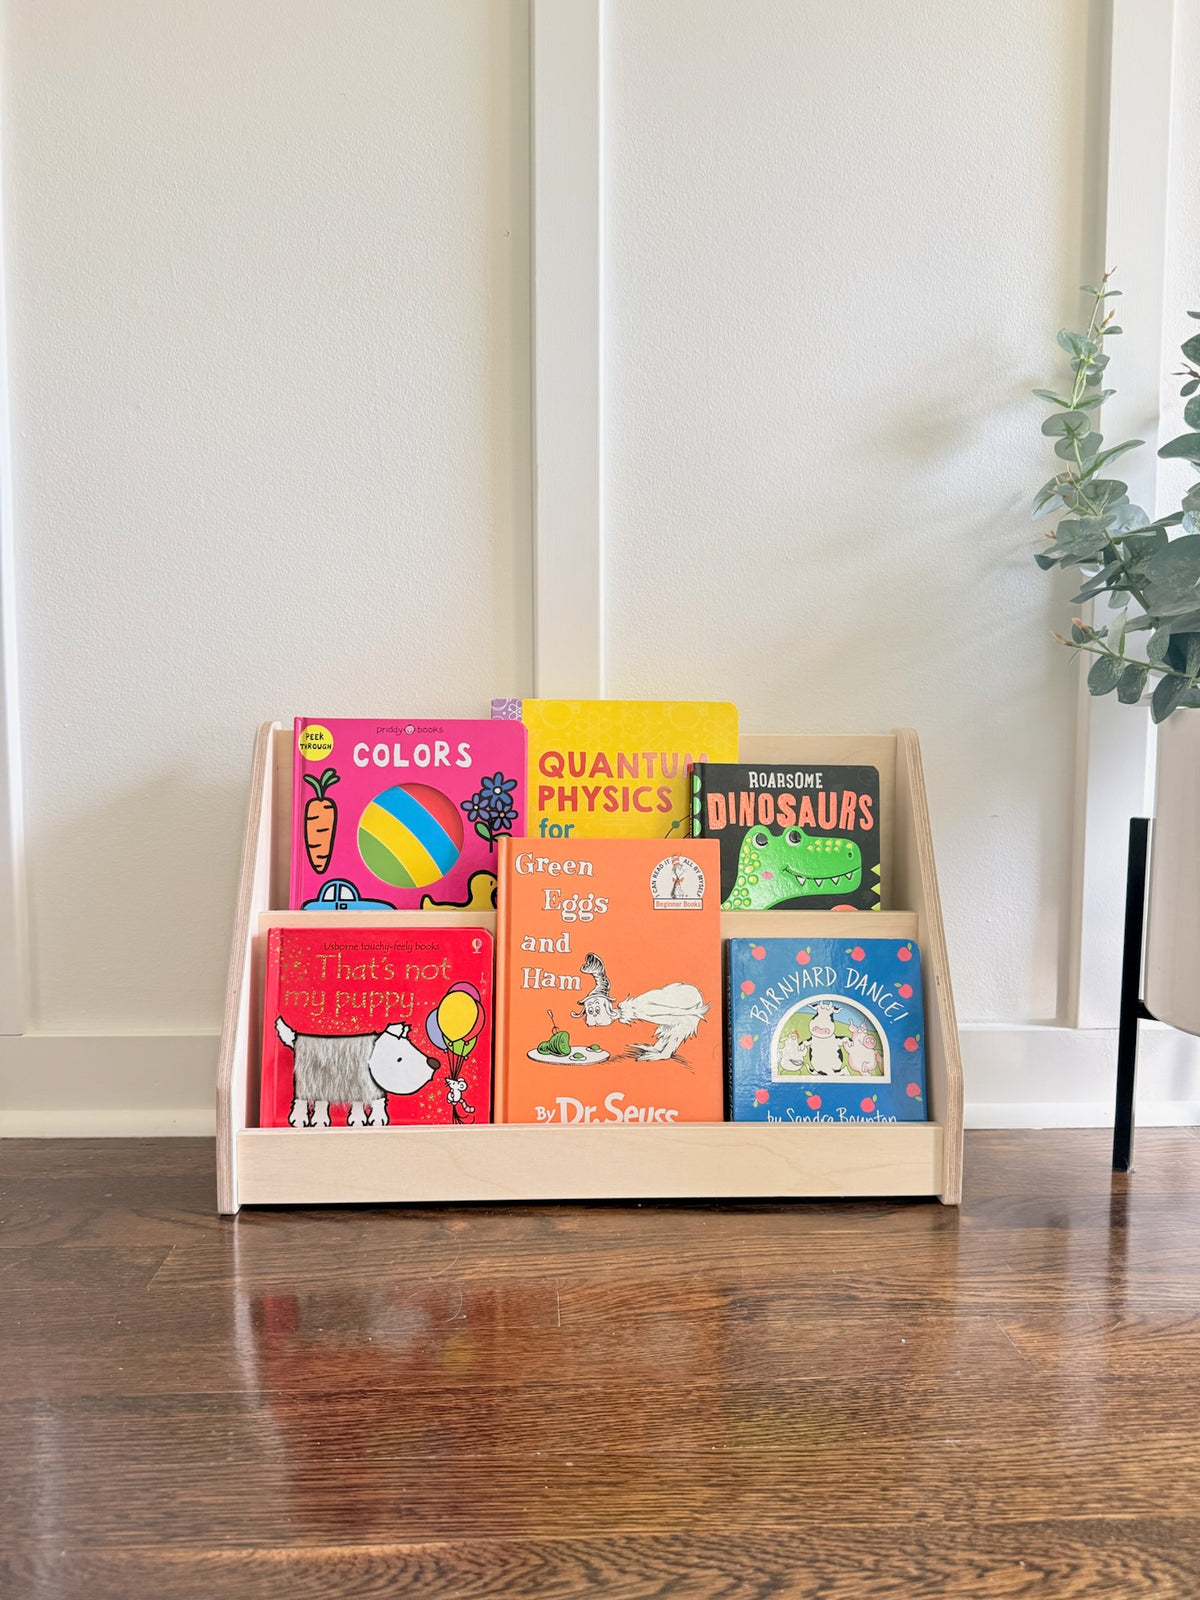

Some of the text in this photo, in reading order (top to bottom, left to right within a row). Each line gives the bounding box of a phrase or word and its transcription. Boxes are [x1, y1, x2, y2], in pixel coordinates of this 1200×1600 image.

[417, 725, 444, 734] books
[353, 740, 472, 768] COLORS
[748, 771, 823, 789] ROARSOME
[538, 785, 673, 813] PHYSICS
[706, 790, 874, 831] DINOSAURS
[538, 817, 575, 838] for
[515, 852, 594, 876] Green
[652, 863, 664, 879] READ
[683, 858, 693, 867] ALL
[693, 865, 700, 874] BY
[542, 889, 609, 923] Eggs
[655, 900, 701, 908] Beginner Books
[323, 941, 440, 953] Usborne touchy-feely books
[520, 932, 572, 953] and
[314, 952, 452, 981] That's not
[521, 967, 582, 991] Ham
[284, 989, 326, 1016] my
[750, 966, 909, 1025] BARNYARD DANCE!
[534, 1106, 556, 1123] By
[602, 1091, 679, 1123] Seuss
